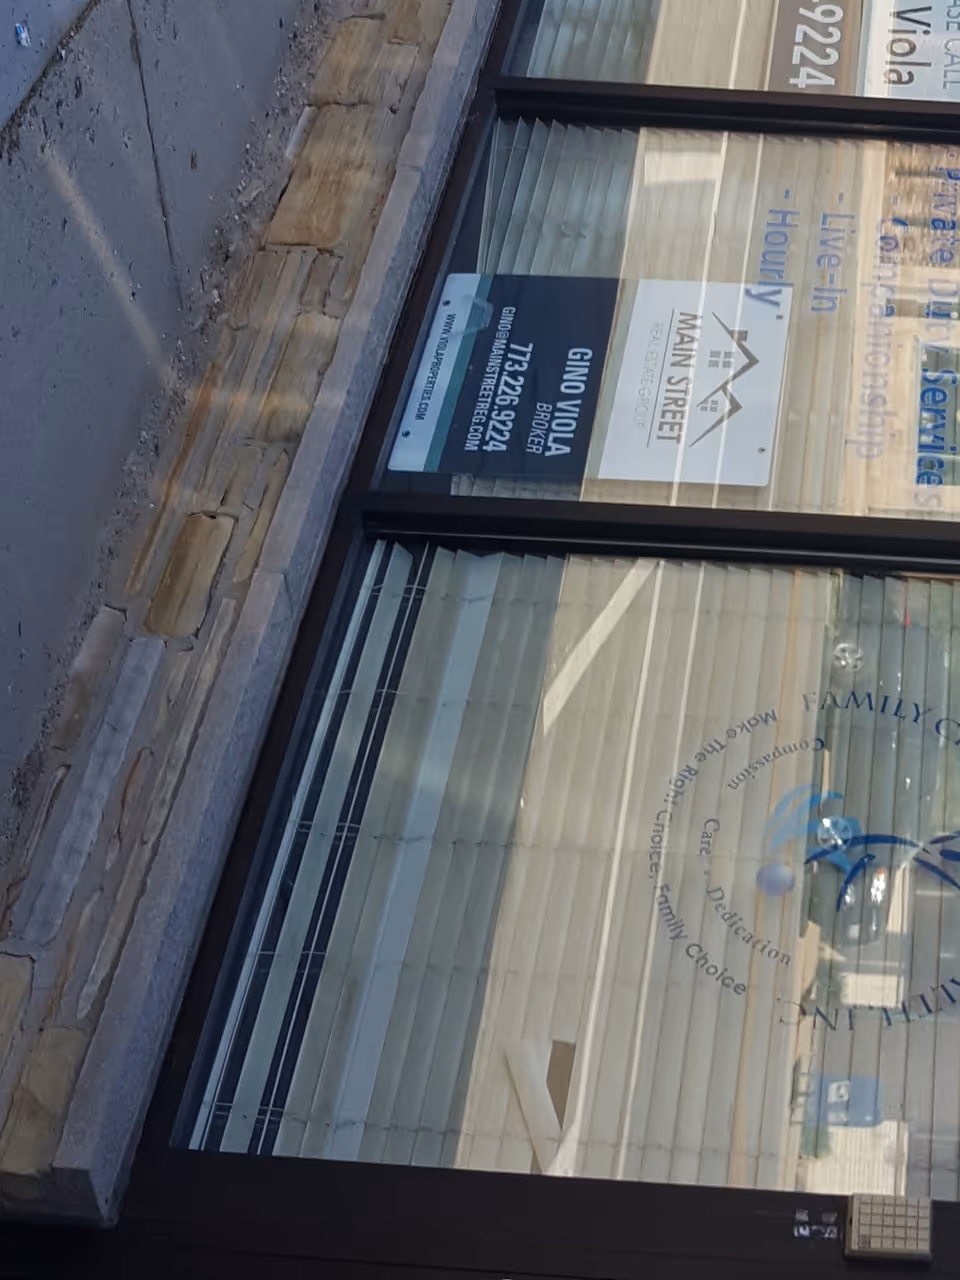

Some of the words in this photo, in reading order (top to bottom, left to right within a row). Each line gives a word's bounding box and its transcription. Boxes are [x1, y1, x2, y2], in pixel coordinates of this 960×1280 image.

[882, 5, 932, 86] Viola
[744, 209, 800, 310] Hourly
[810, 212, 856, 313] Live-In
[414, 313, 456, 421] WWW.VIOLAPROPERTIES.COM
[670, 312, 702, 369] MAIN
[464, 306, 516, 451] GINO@MAINSTREETREG.COM
[482, 342, 534, 452] 773.226.9224
[558, 348, 594, 395] GINO
[524, 402, 552, 455] BROKER
[544, 399, 582, 457] VIOLA
[656, 376, 692, 445] STREET
[914, 368, 958, 508] Services
[724, 708, 778, 739] Make
[800, 690, 932, 725] FAMILY
[694, 738, 726, 763] The
[726, 737, 824, 790] Compassion
[662, 764, 698, 807] Right
[648, 809, 672, 880] Choice,
[698, 818, 720, 856] Care
[652, 883, 688, 942] Family
[704, 885, 792, 967] Dedication
[684, 943, 746, 995] Choice
